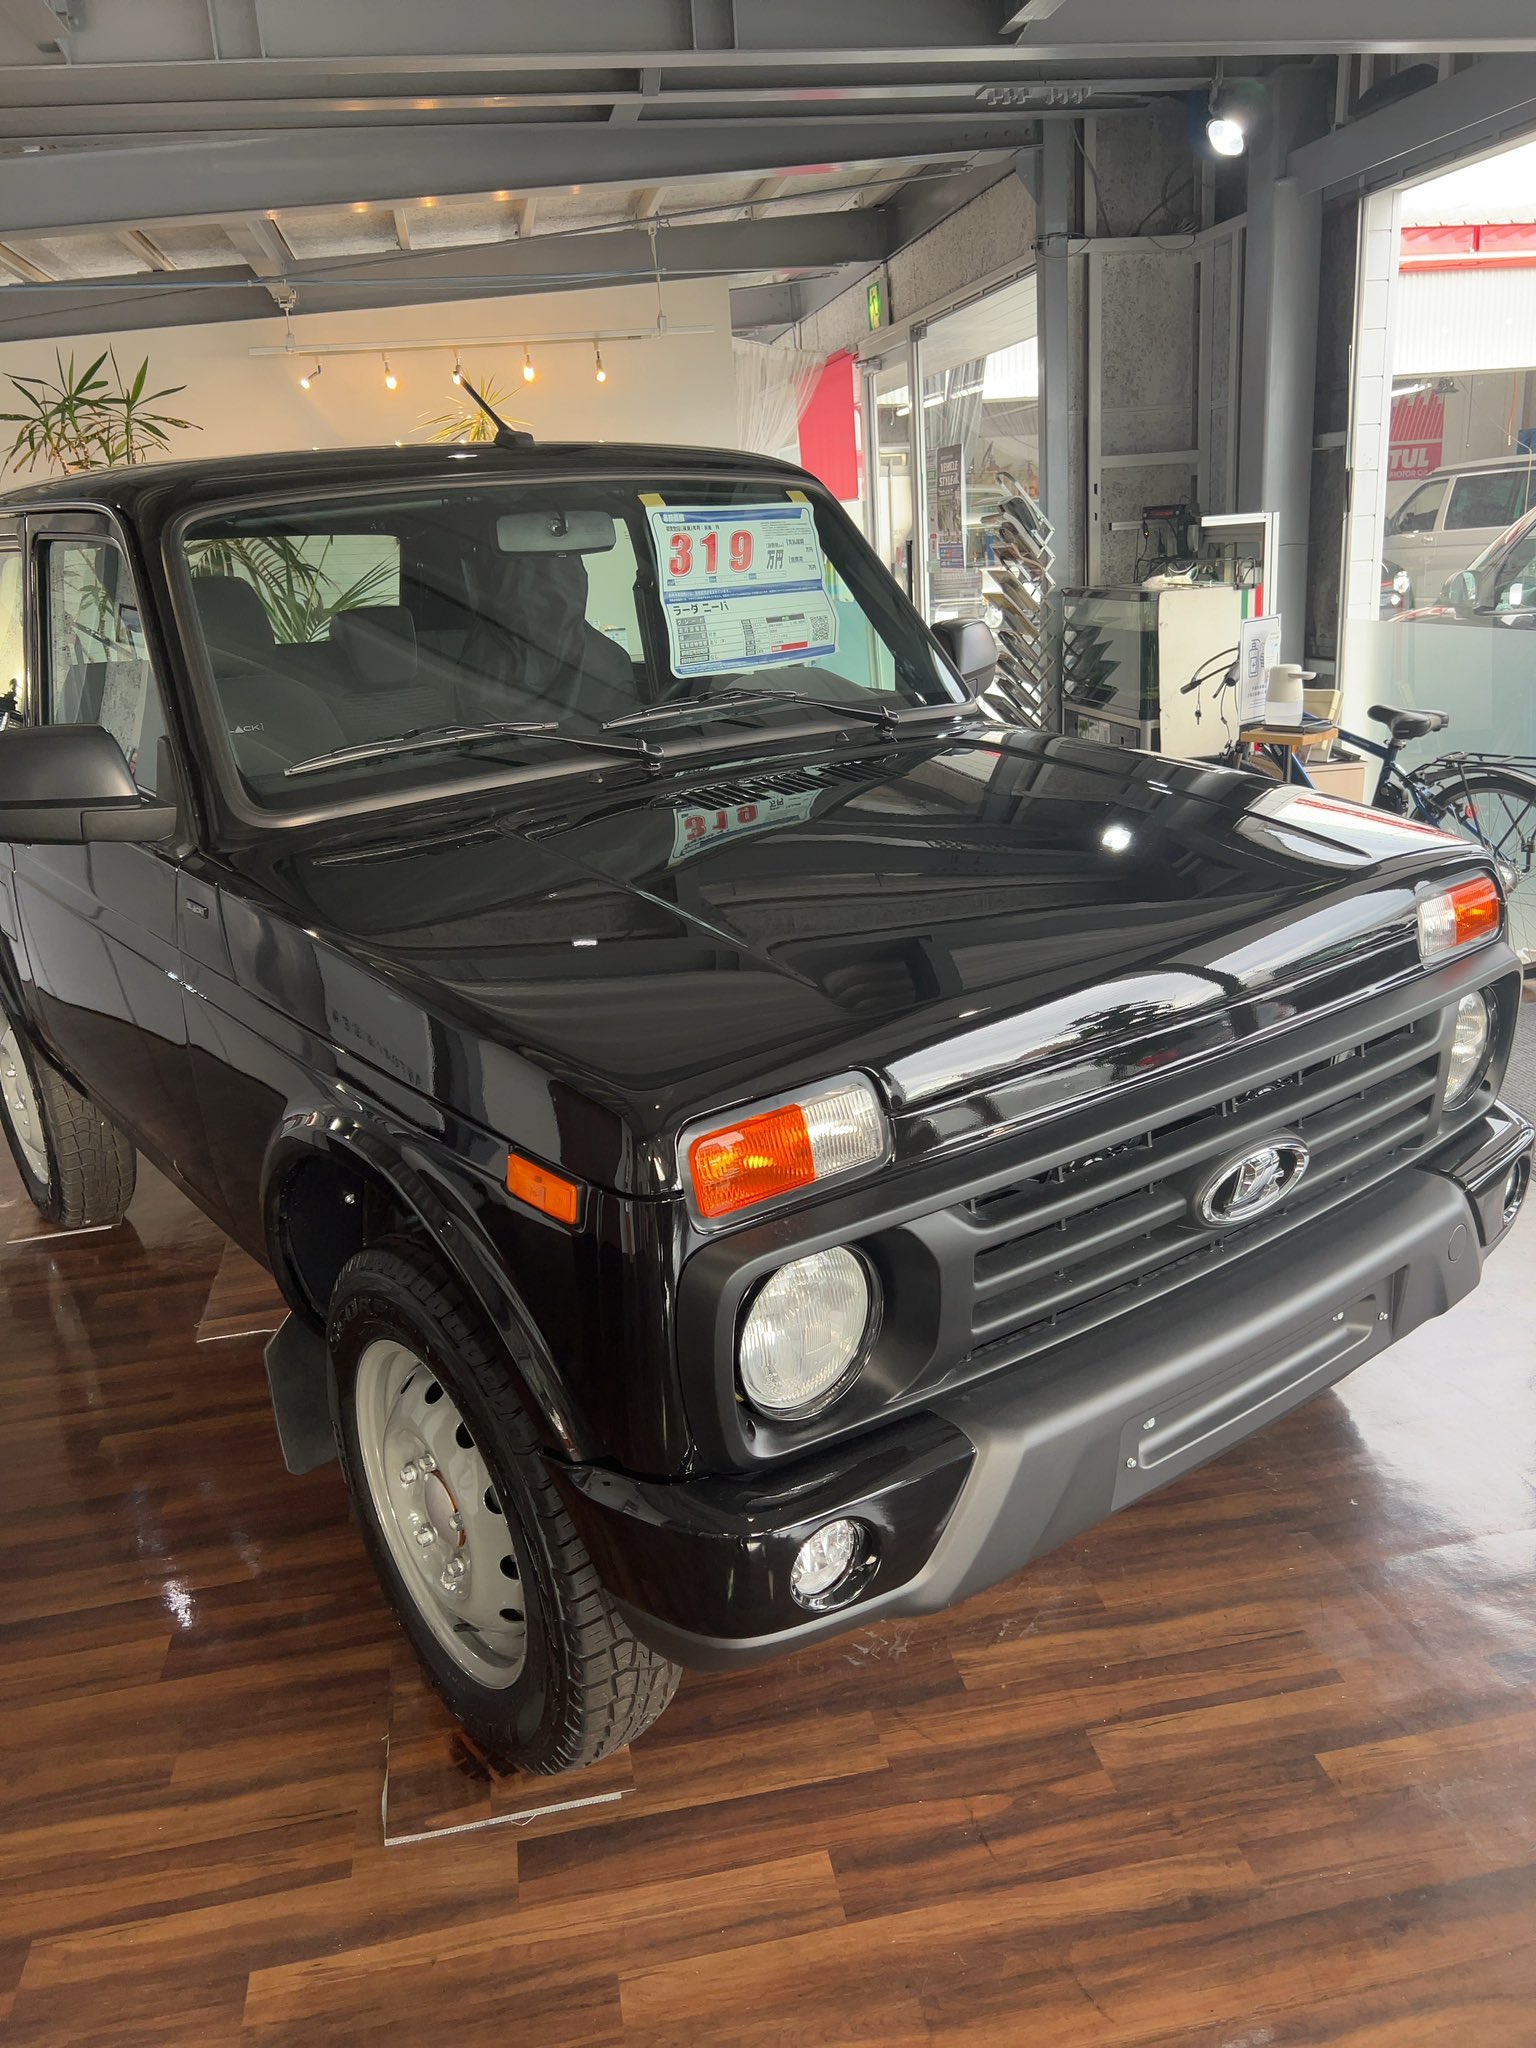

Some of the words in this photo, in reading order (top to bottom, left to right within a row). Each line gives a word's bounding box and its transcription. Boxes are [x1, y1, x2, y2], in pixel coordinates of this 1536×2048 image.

[940, 460, 959, 473] VEHICLE
[939, 476, 954, 487] STYLE
[669, 530, 754, 577] 319
[767, 549, 784, 569] 万円
[673, 604, 698, 615] ラーダ
